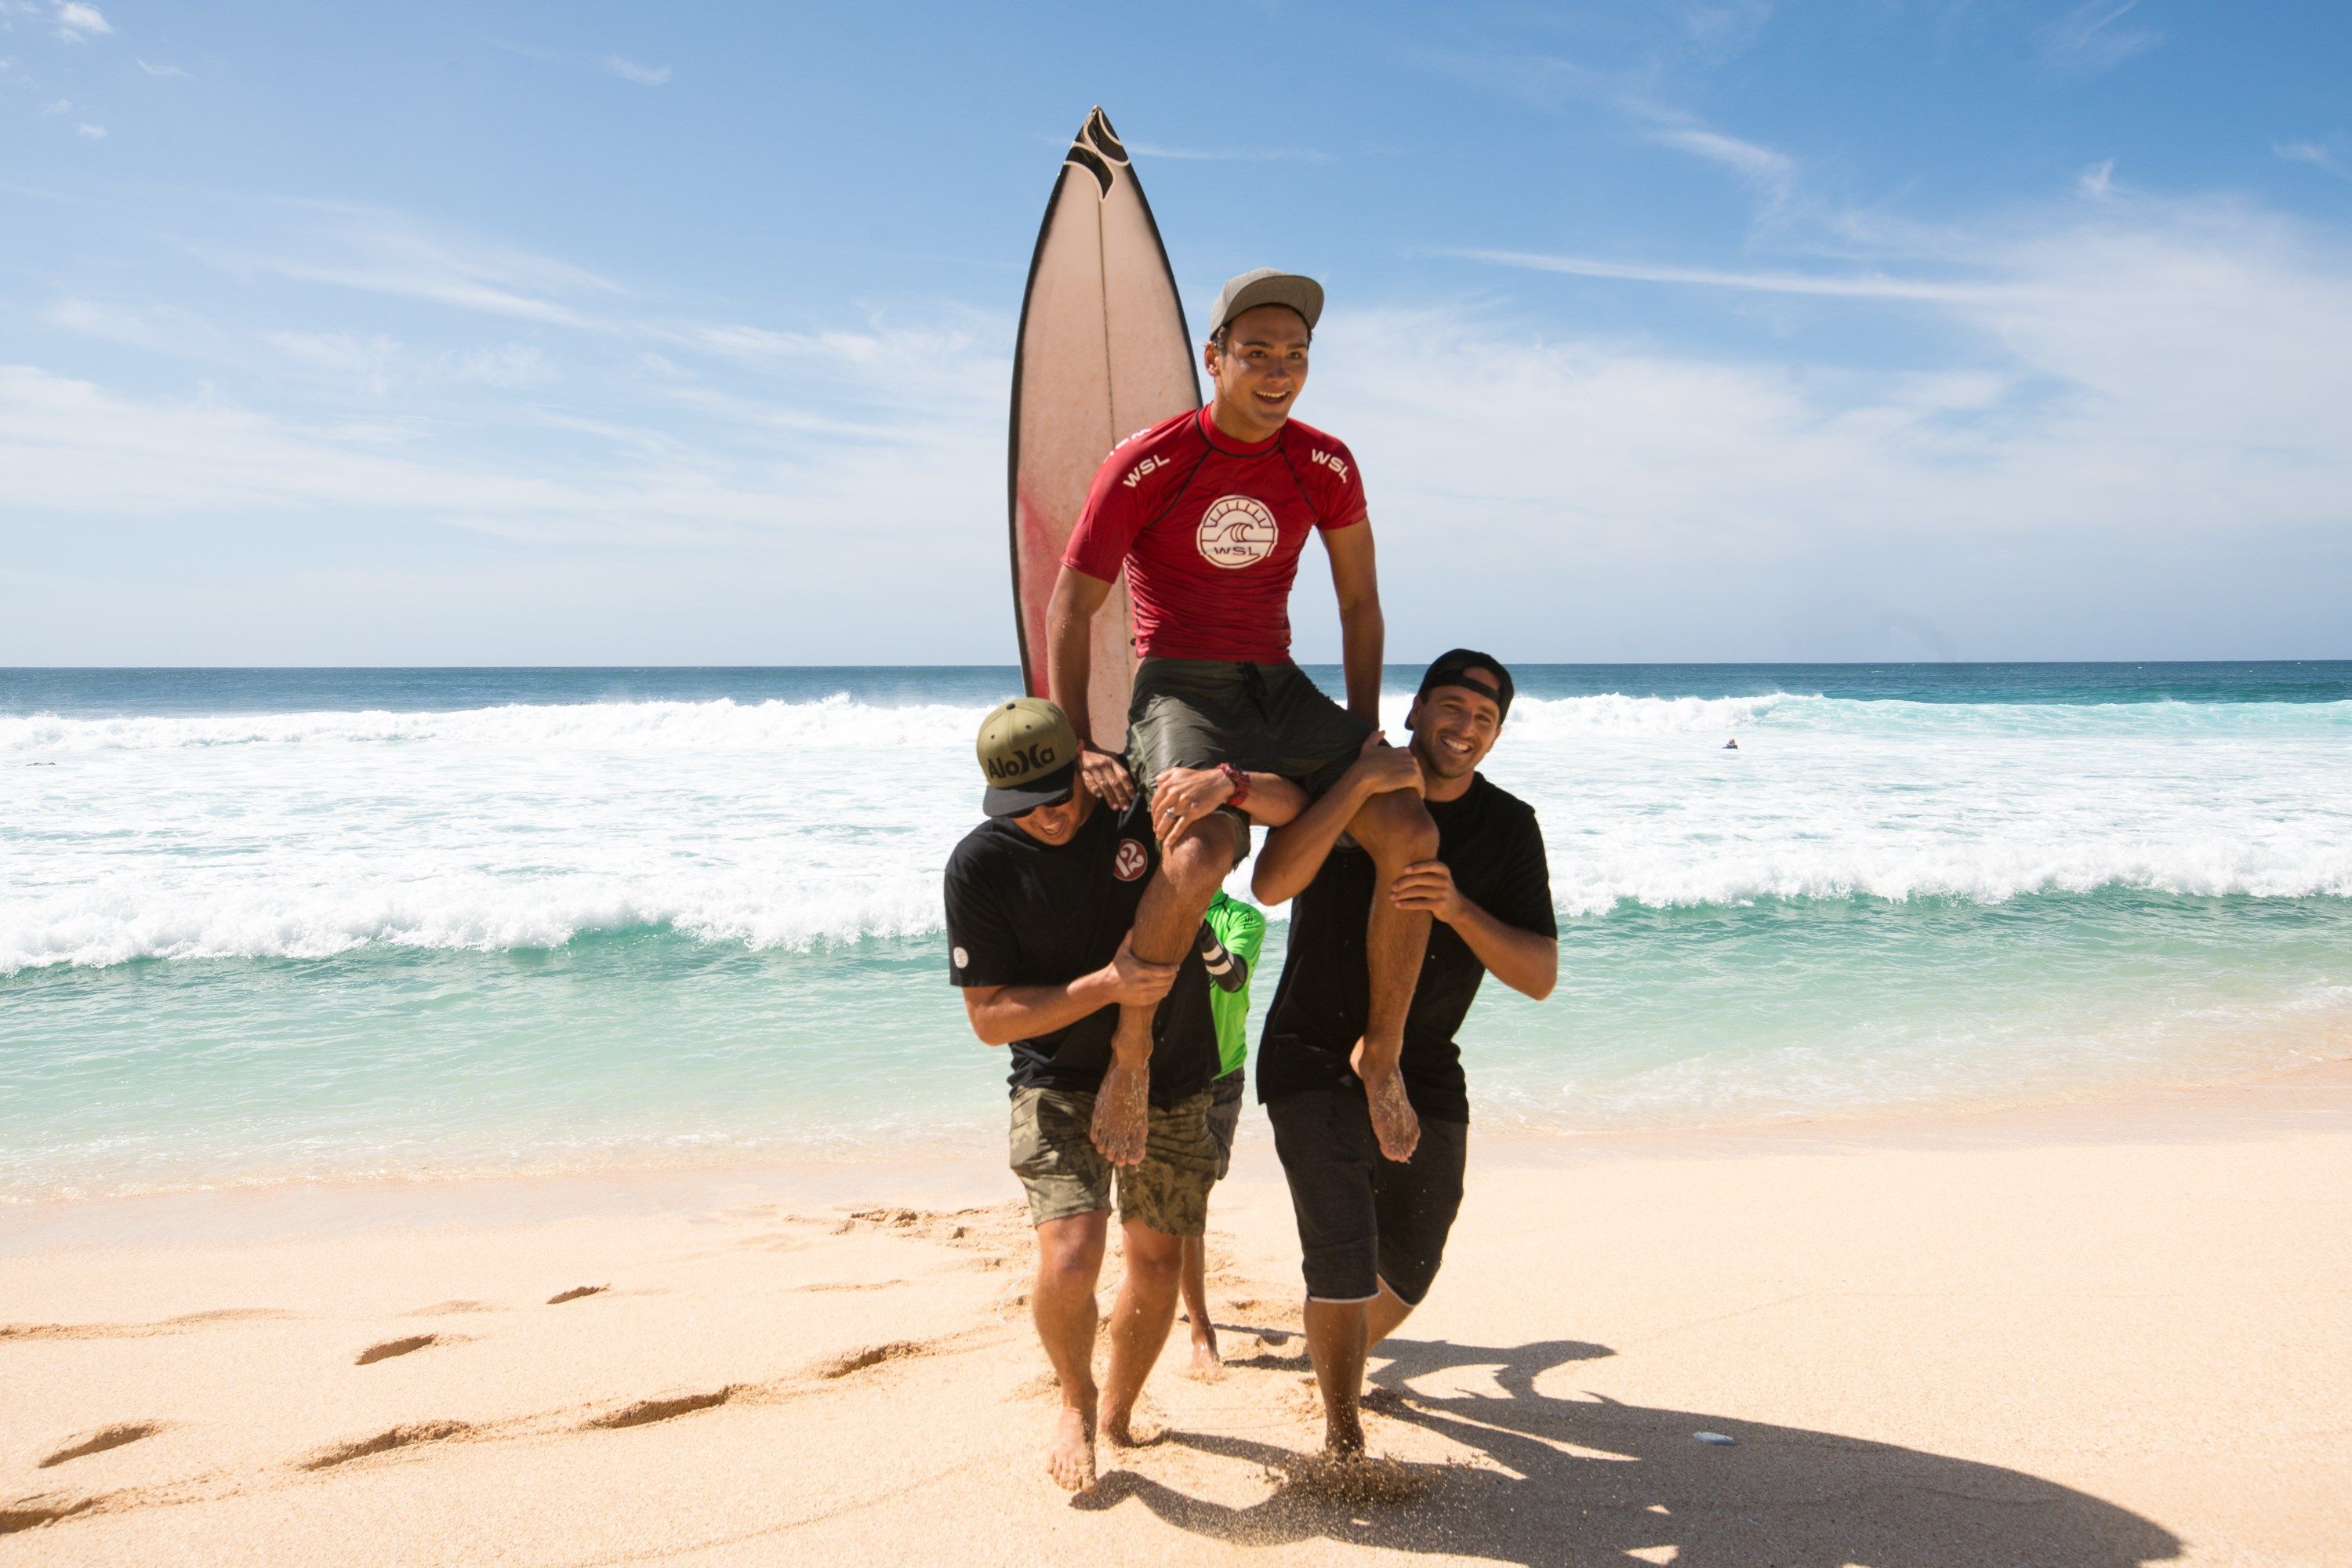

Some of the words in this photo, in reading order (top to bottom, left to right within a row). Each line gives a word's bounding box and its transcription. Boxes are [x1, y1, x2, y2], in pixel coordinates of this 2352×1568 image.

[1123, 454, 1171, 488] WSL
[1312, 448, 1348, 484] WSL
[1214, 546, 1260, 556] WSL
